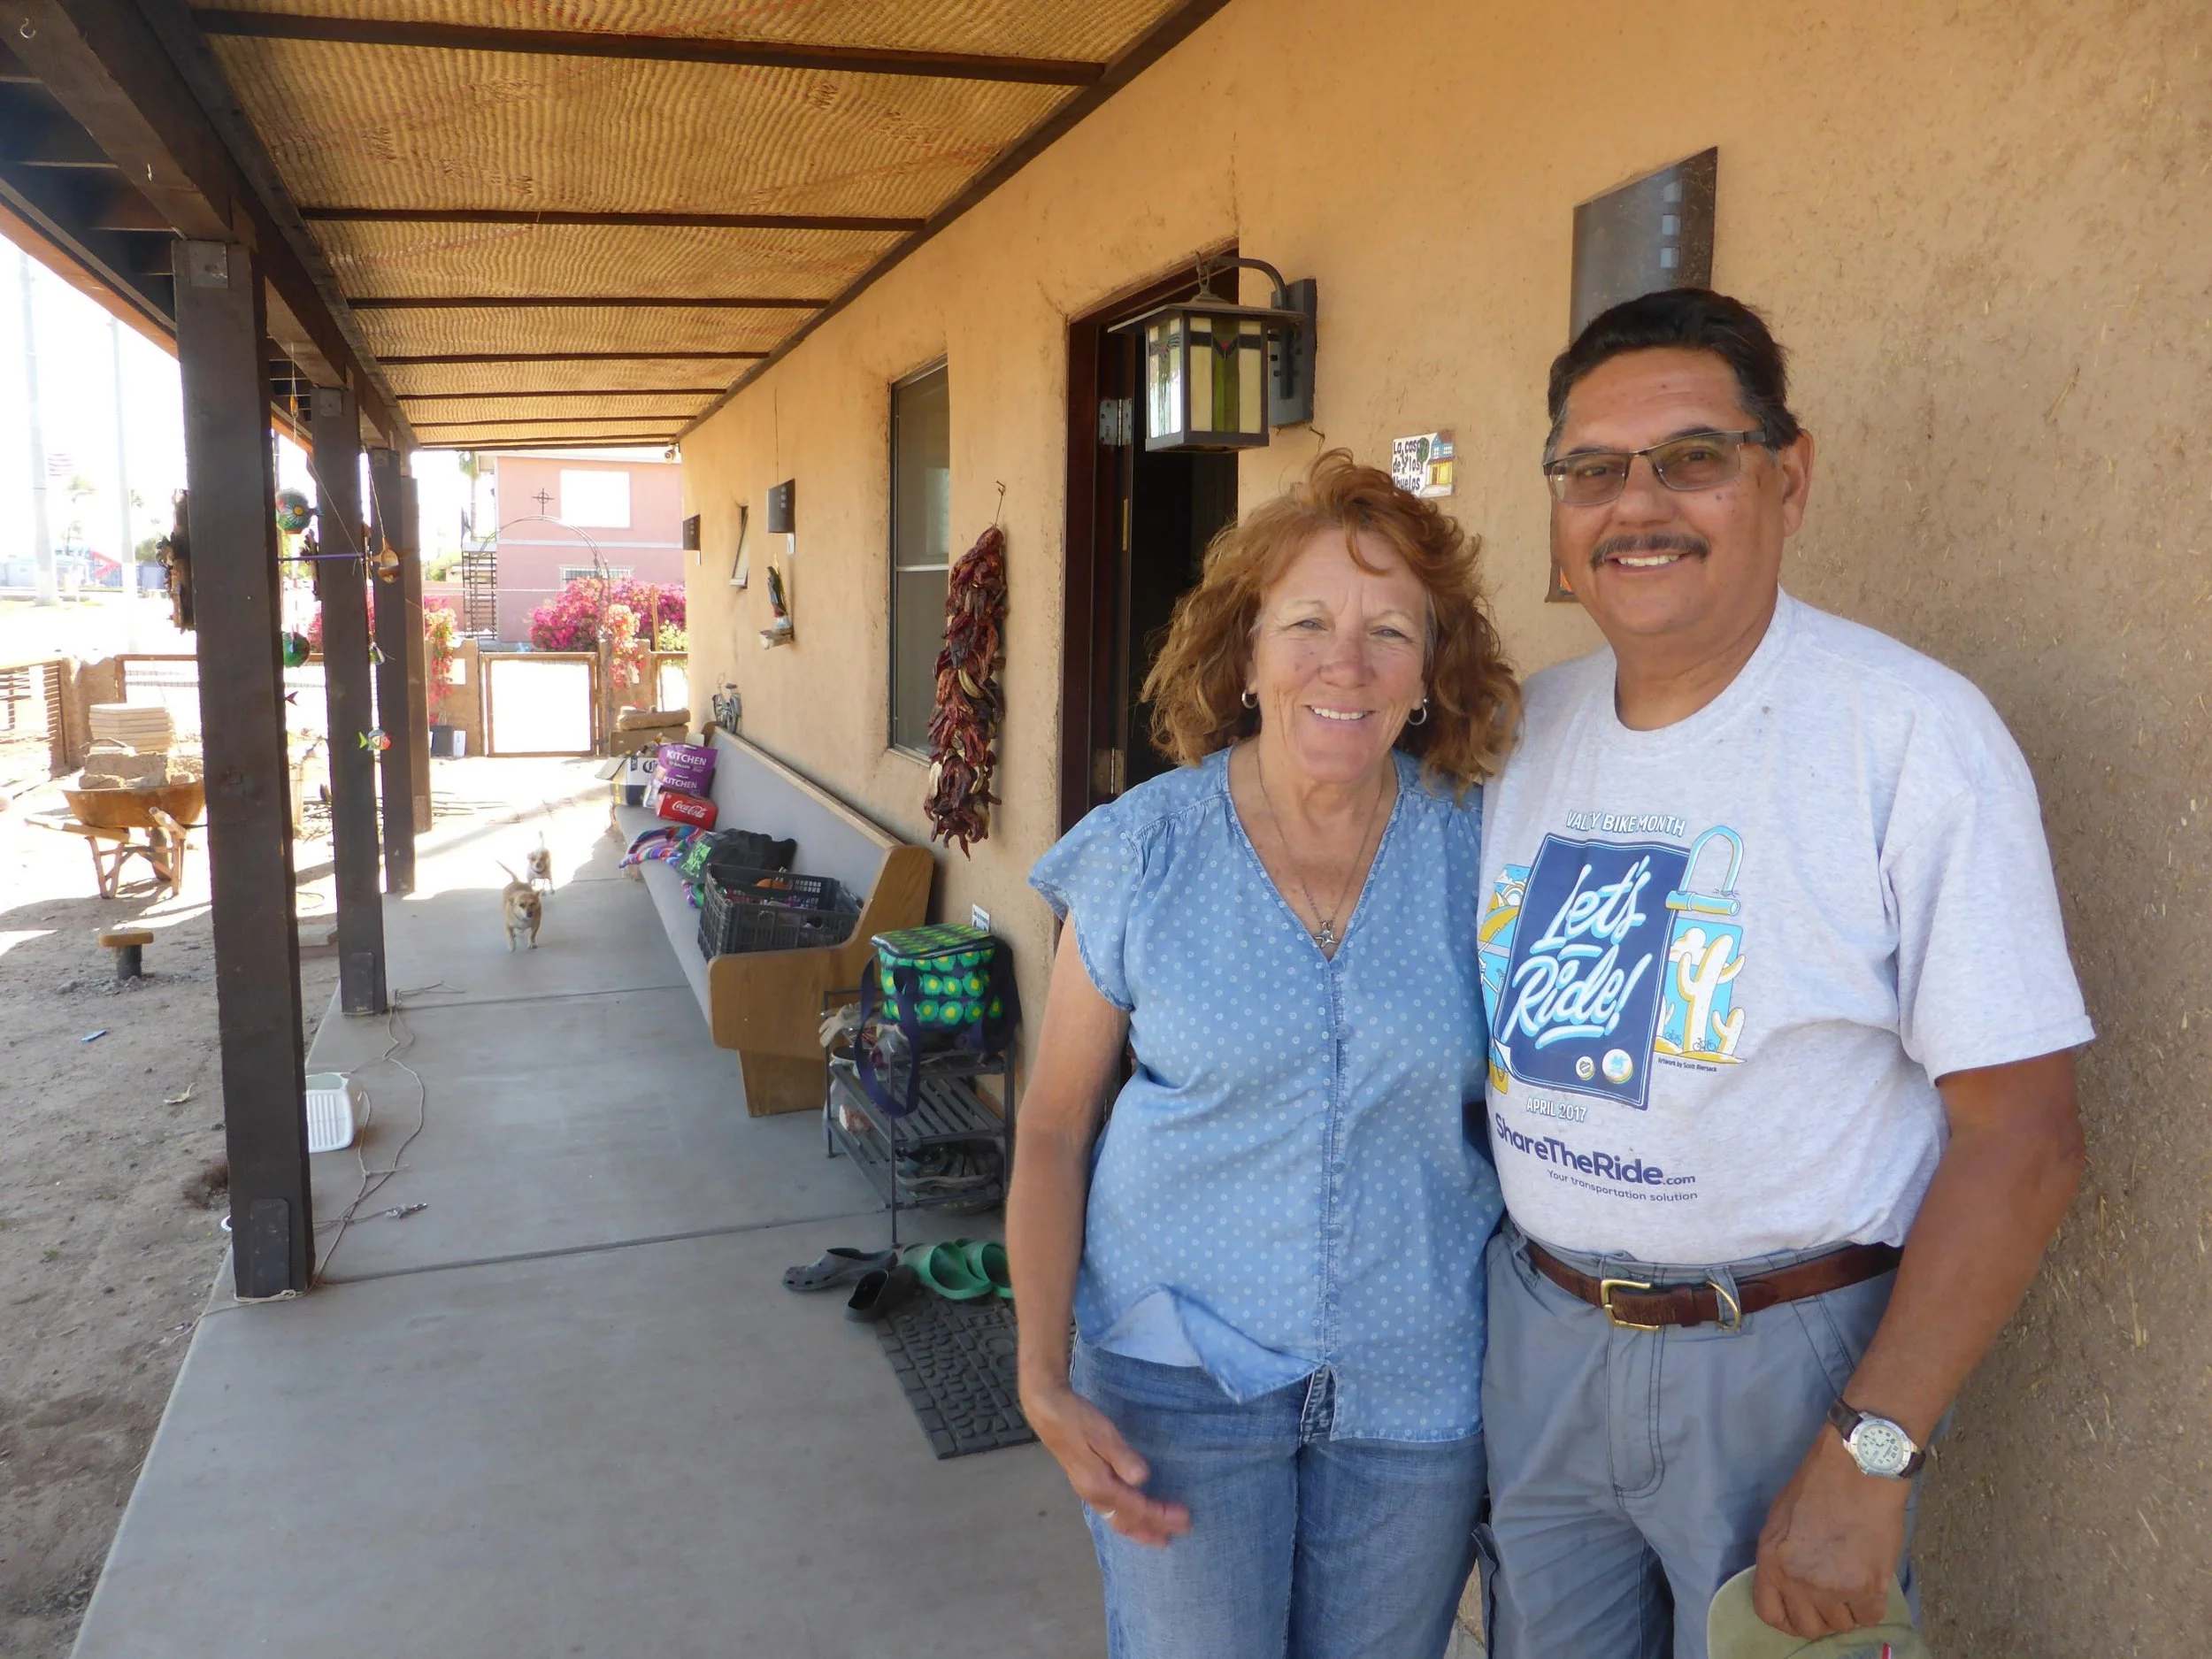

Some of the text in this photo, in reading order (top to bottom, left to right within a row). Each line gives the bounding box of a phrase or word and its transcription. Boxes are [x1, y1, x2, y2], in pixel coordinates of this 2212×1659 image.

[1394, 442, 1402, 454] La
[1393, 457, 1401, 472] de
[666, 749, 707, 766] KITCHEN
[663, 776, 697, 789] KITCHEN
[1566, 810, 1686, 838] VALY BIKE MONTH
[1529, 855, 1651, 955] Let's
[1501, 943, 1653, 1043] Ride!
[1525, 1095, 1587, 1123] APRIL 2017
[1495, 1112, 1696, 1186] ShareTheRide.com
[1547, 1168, 1698, 1202] Your transportation solution
